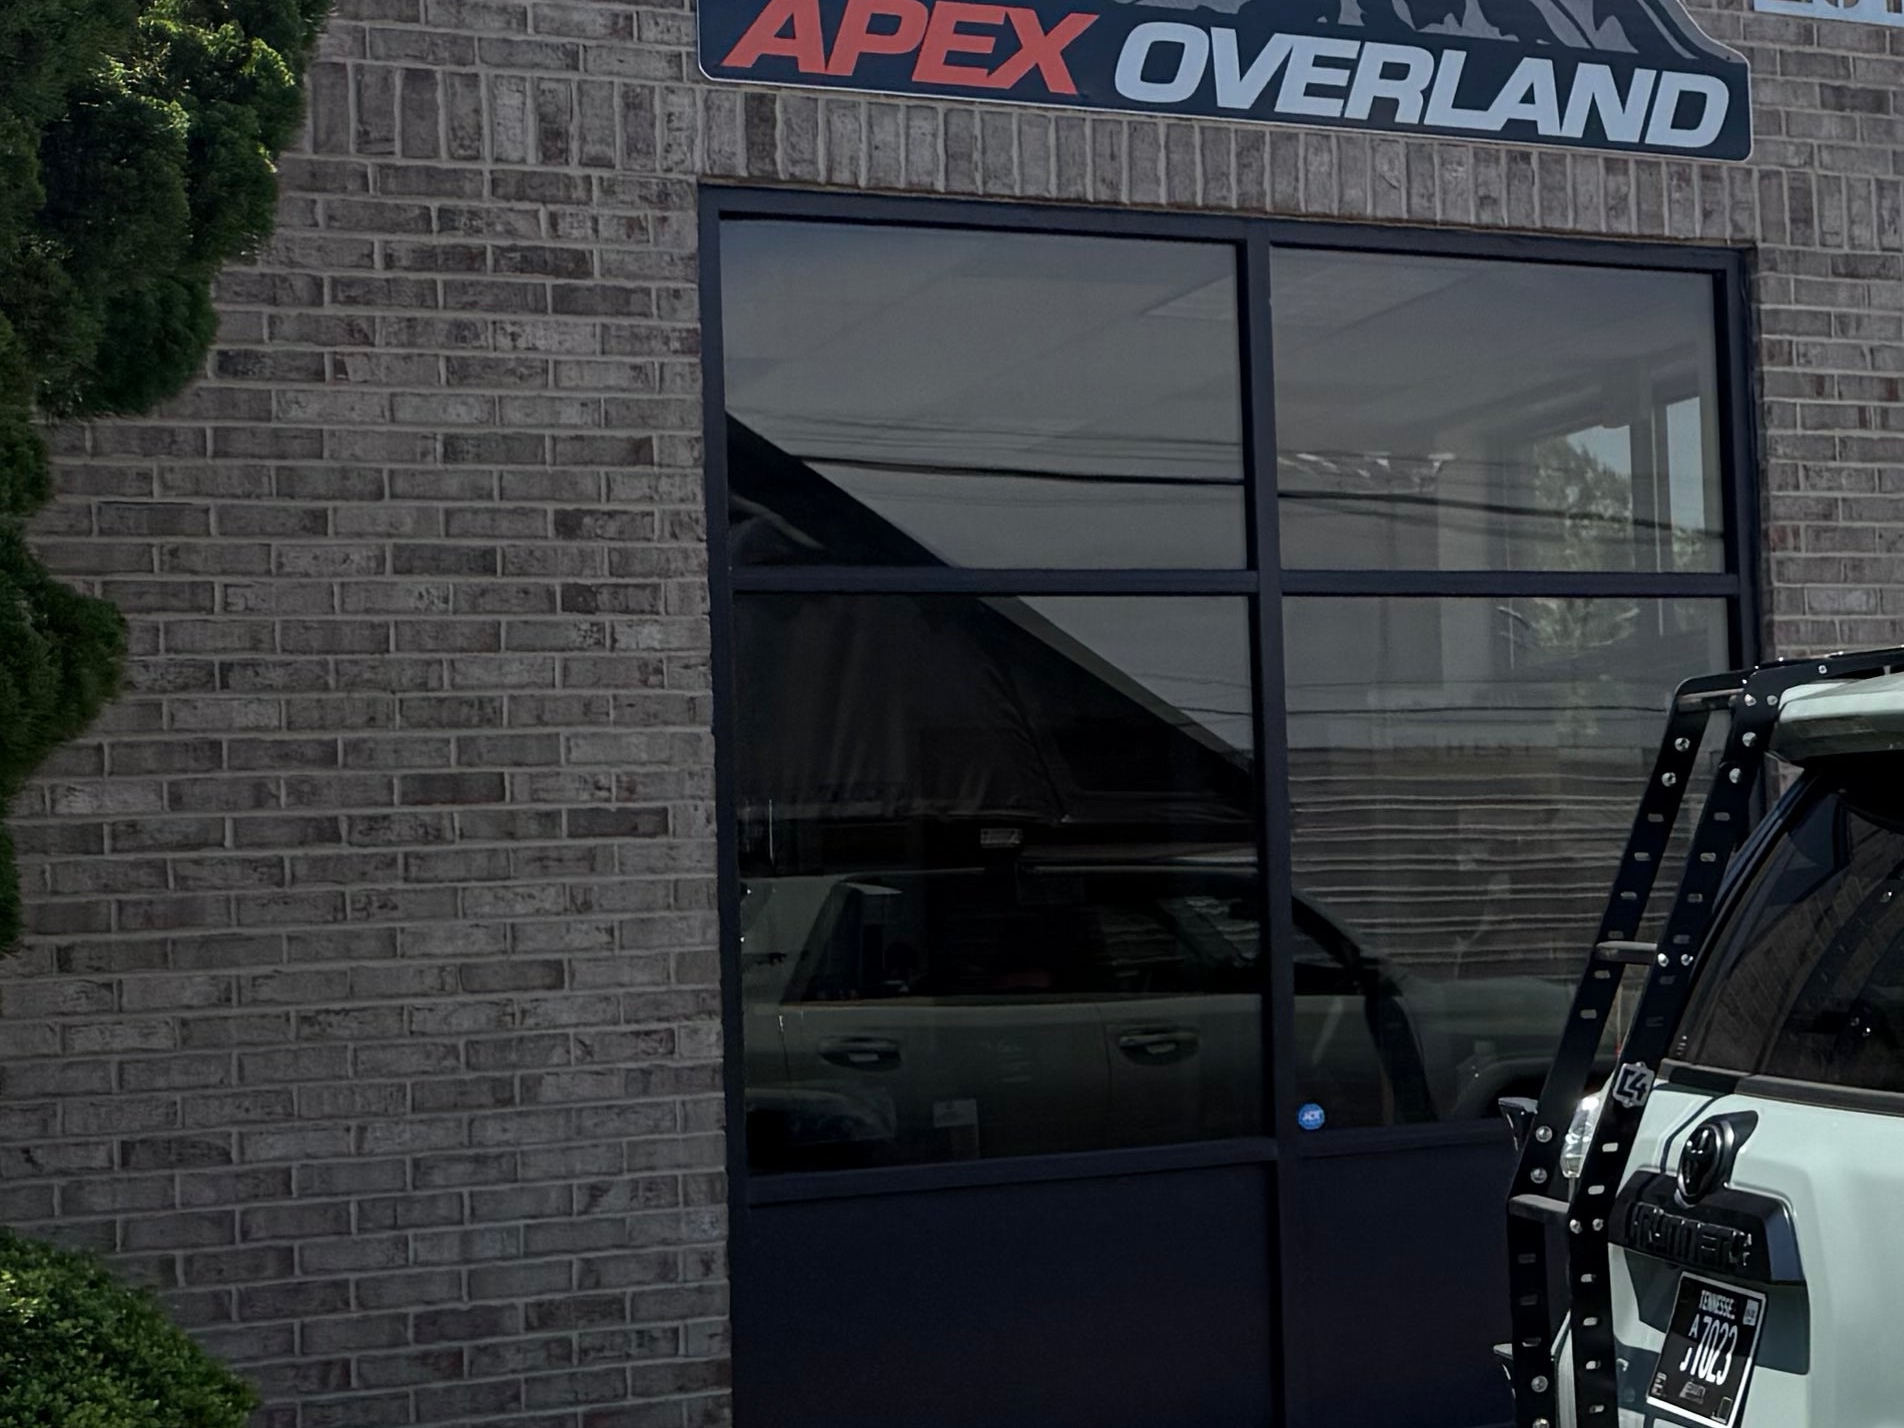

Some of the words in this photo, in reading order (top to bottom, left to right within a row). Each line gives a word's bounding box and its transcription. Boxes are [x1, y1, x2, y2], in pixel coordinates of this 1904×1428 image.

[1114, 21, 1730, 148] OVERLAND
[1616, 1067, 1647, 1101] C4
[1690, 1316, 1738, 1385] 7023
